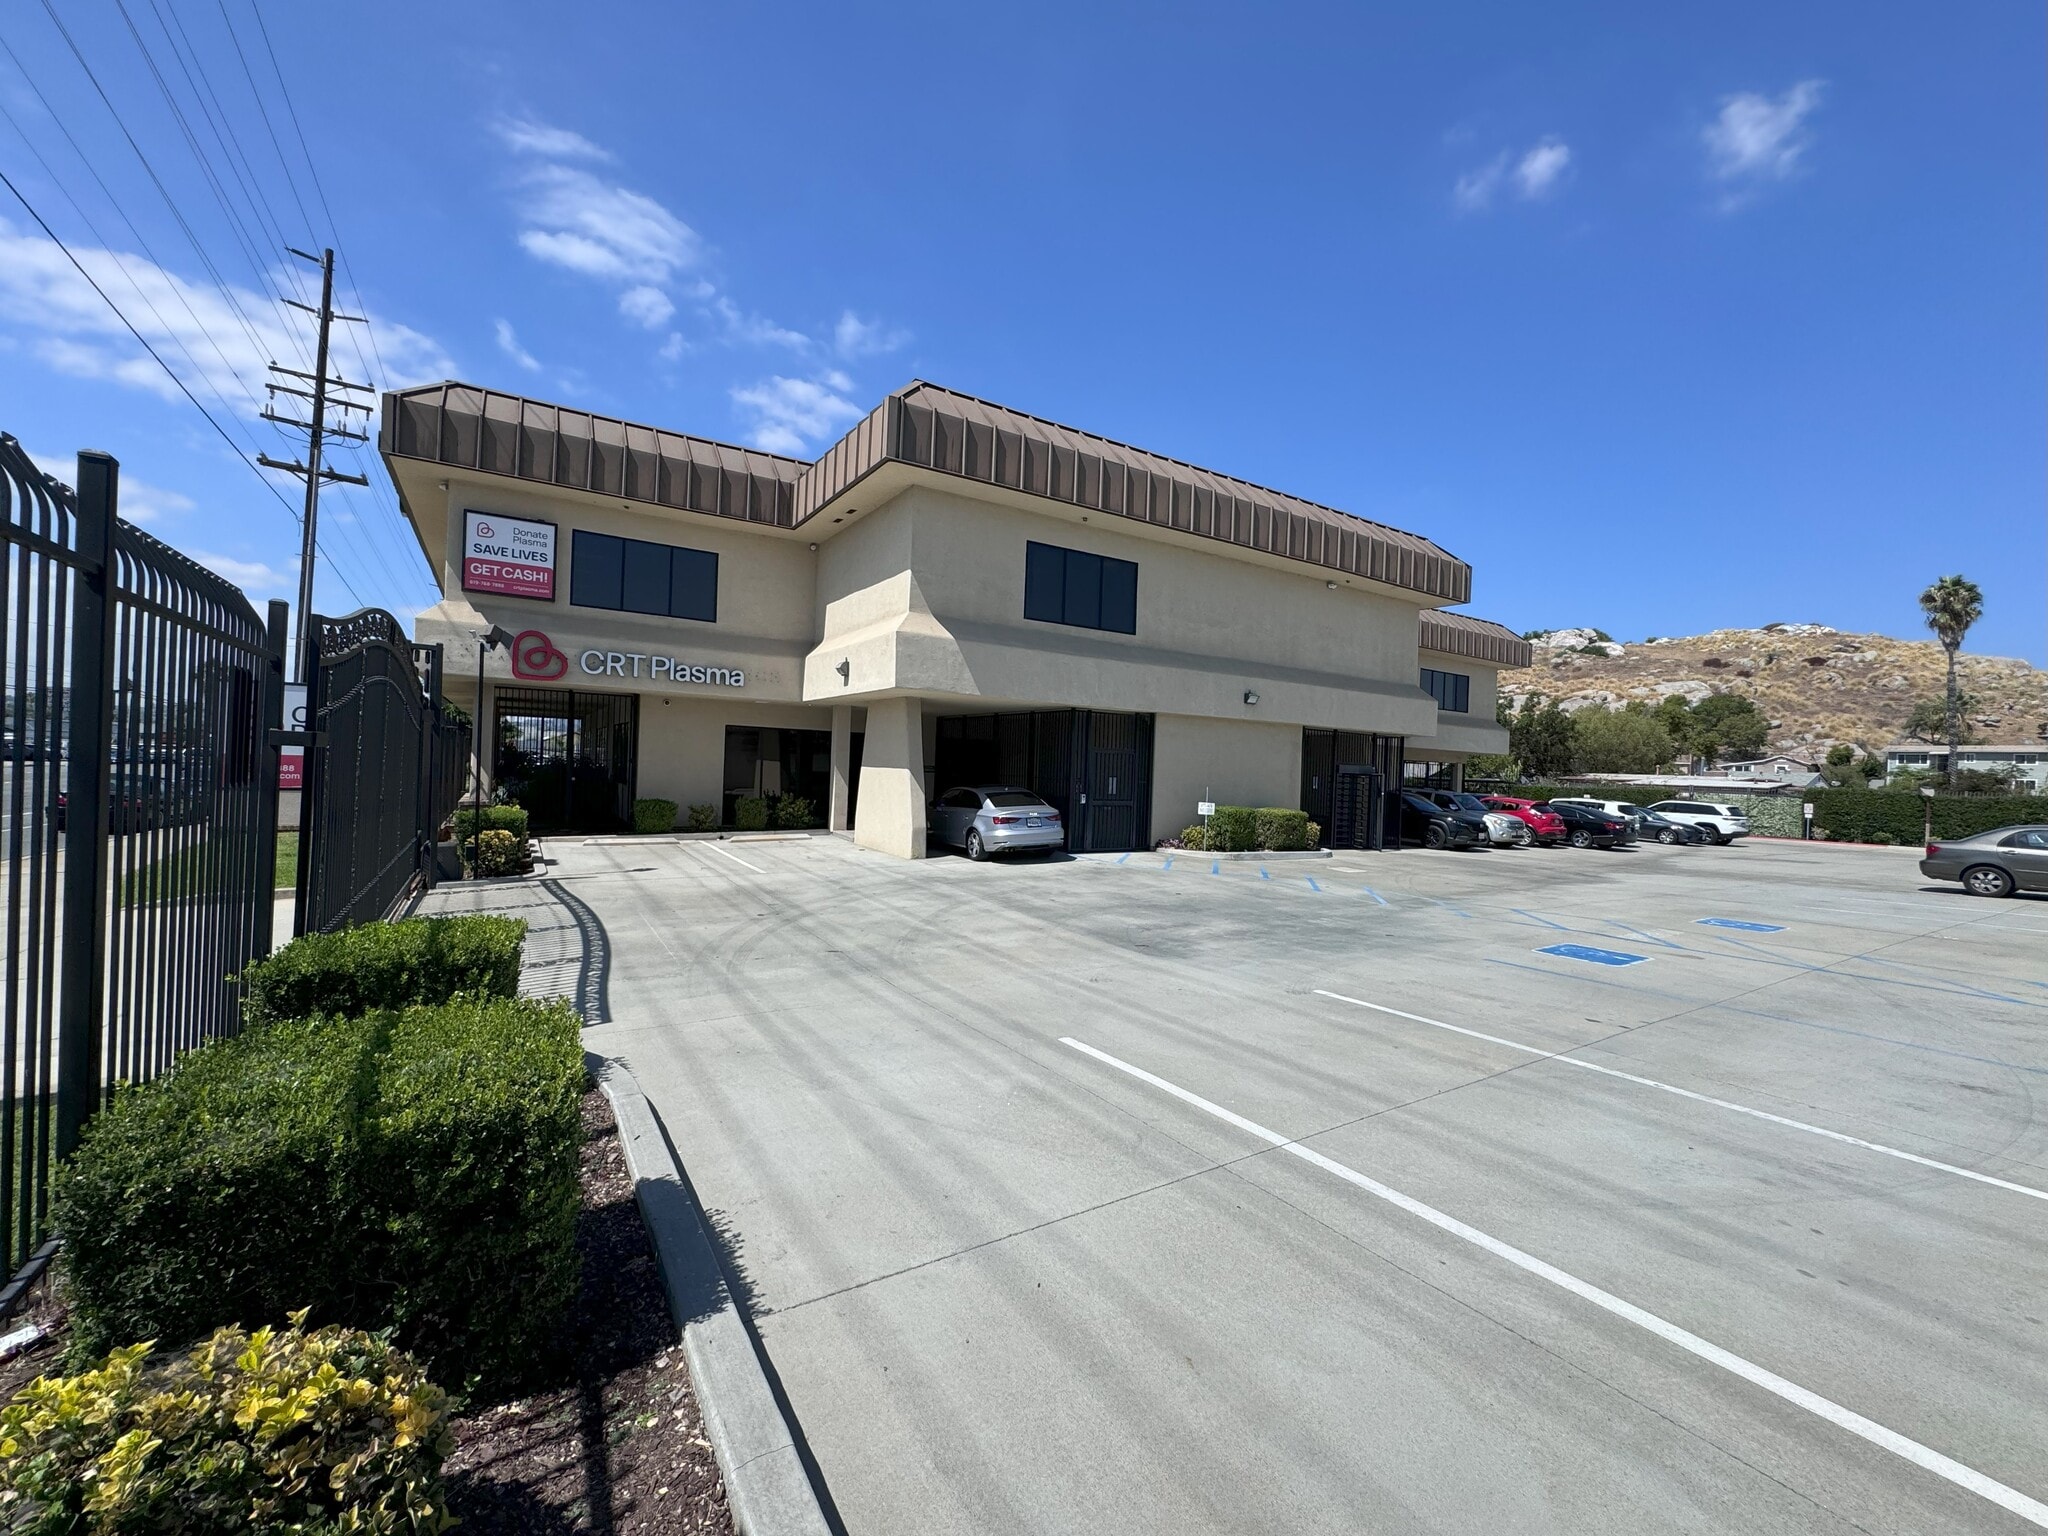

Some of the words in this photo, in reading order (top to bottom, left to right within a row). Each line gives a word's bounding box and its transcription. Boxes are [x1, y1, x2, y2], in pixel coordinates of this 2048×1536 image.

[512, 536, 548, 548] Plasma
[513, 527, 548, 540] Donate
[473, 542, 509, 557] SAVE
[511, 548, 548, 563] LIVES
[470, 562, 501, 577] GET
[502, 567, 548, 583] CASH!
[580, 649, 647, 678] CRT
[651, 655, 745, 687] Plasma
